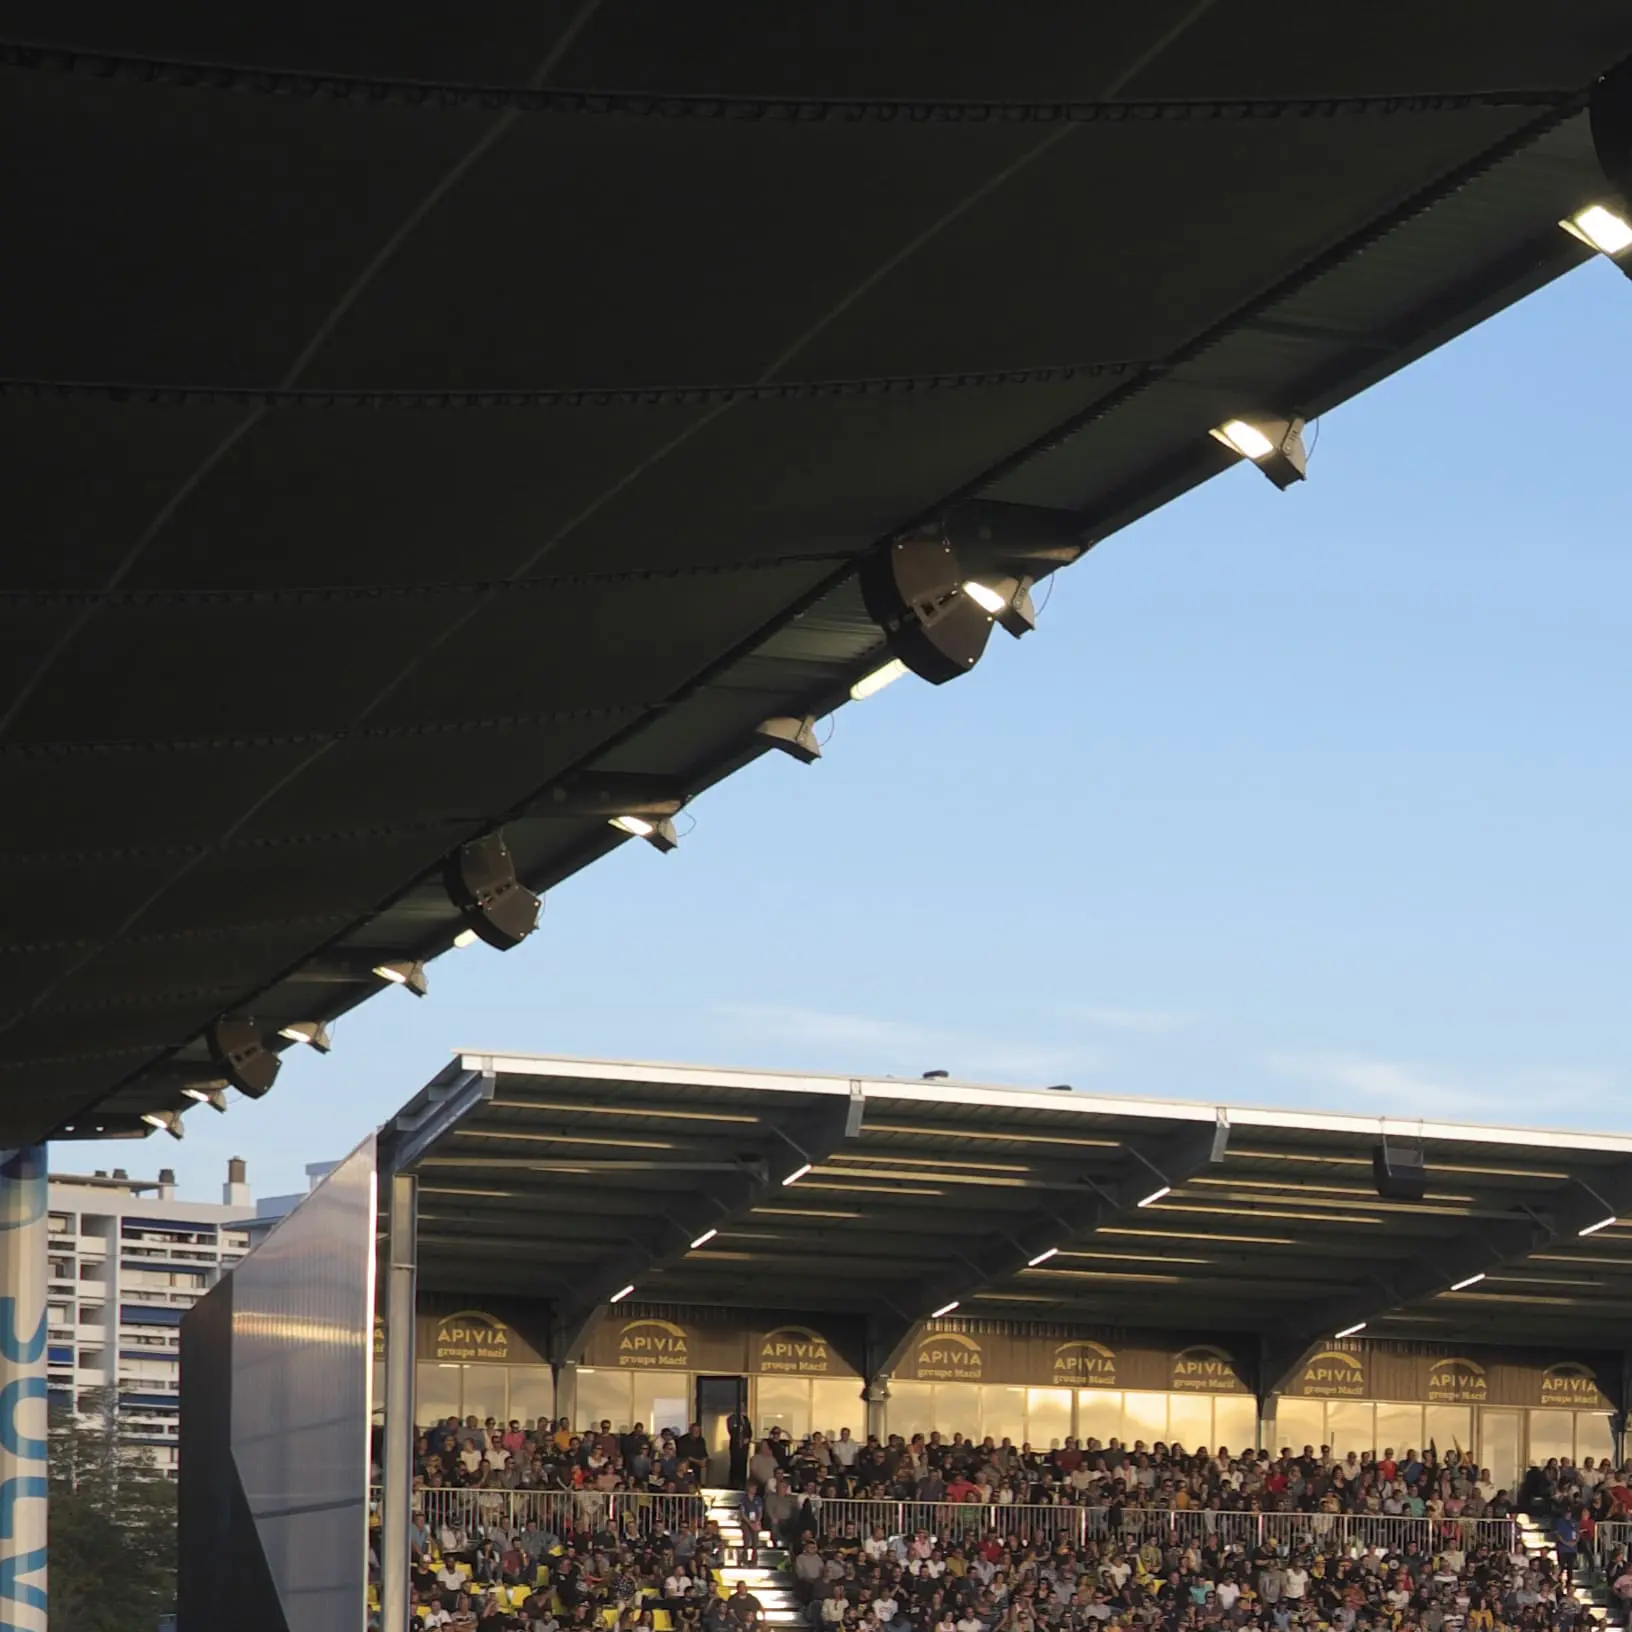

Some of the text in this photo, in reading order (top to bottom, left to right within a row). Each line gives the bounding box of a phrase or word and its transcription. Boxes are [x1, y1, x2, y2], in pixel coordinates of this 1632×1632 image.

[437, 1328, 507, 1345] APIVIA
[620, 1336, 687, 1353] APIVIA
[761, 1342, 827, 1359] APIVIA
[918, 1351, 982, 1366] APIVIA
[1053, 1356, 1117, 1373] APIVIA
[1173, 1360, 1235, 1376] APIVIA
[1304, 1367, 1364, 1383] APIVIA
[1429, 1374, 1487, 1389] APIVIA
[1542, 1377, 1598, 1392] APIVIA
